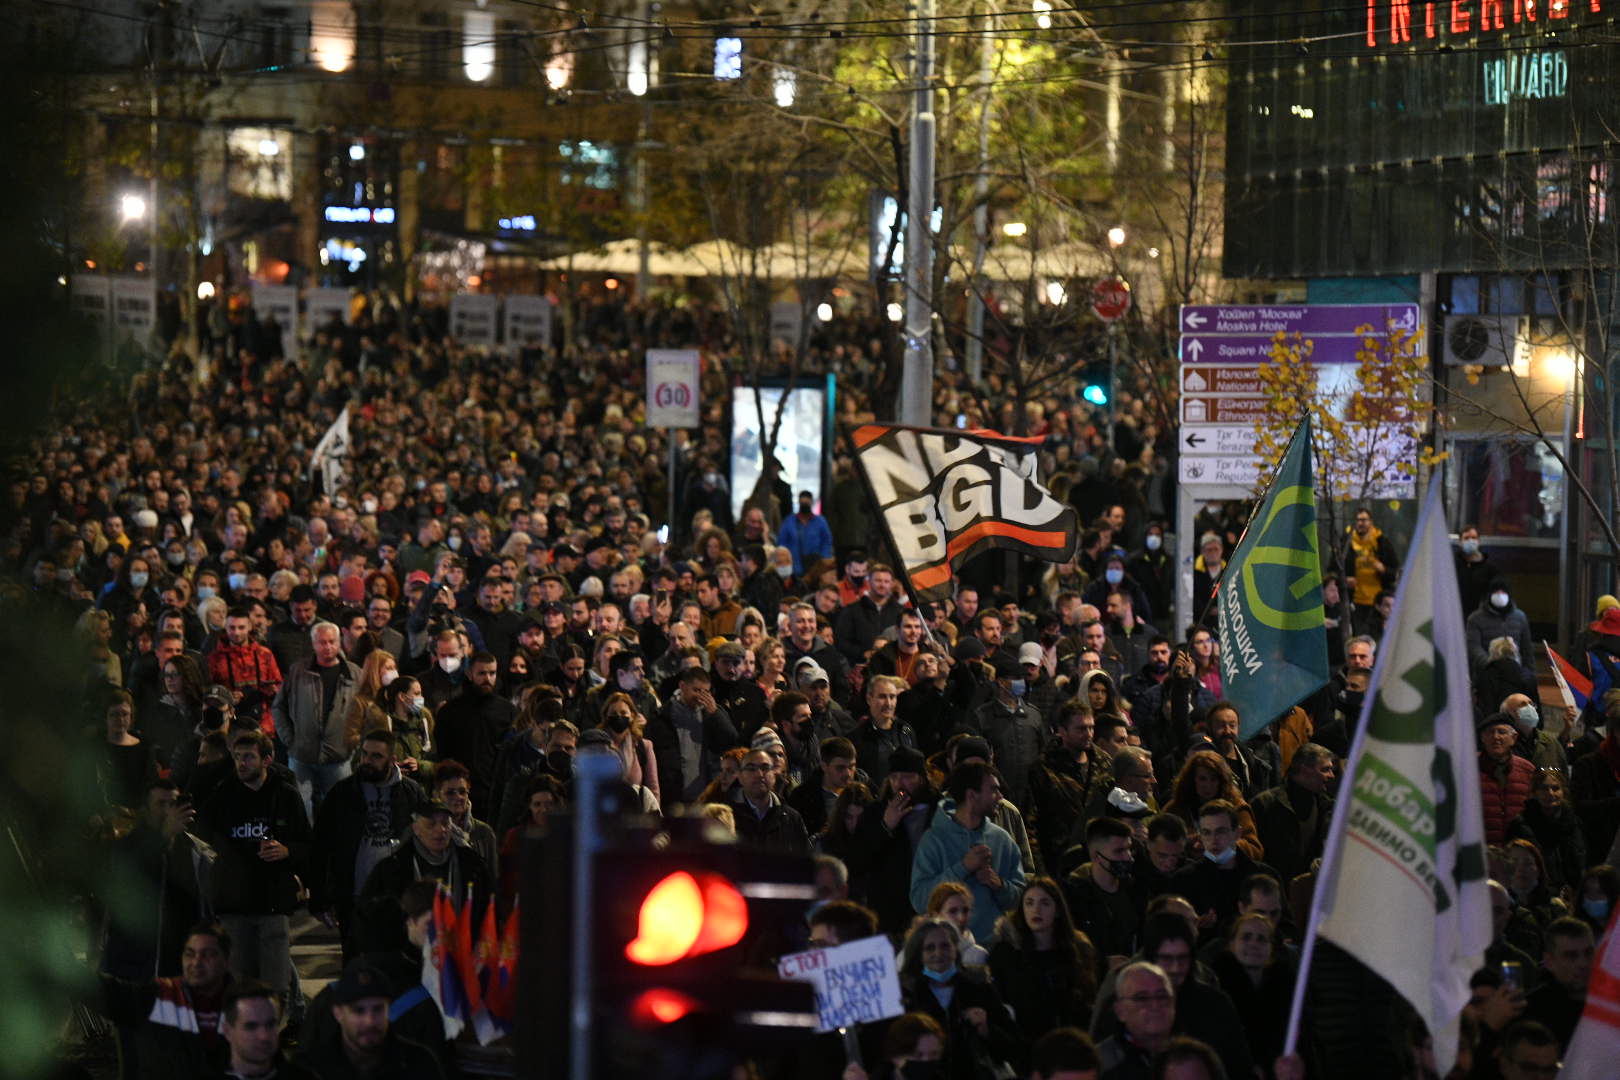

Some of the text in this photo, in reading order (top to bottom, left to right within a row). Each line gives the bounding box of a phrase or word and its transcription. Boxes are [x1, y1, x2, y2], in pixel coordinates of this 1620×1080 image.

[1216, 320, 1288, 331] Moskva Hotel
[1218, 343, 1256, 357] Square
[1216, 380, 1258, 392] National
[663, 387, 685, 406] 30
[883, 463, 1065, 571] BGD
[1218, 594, 1240, 686] СТАНАК
[231, 822, 269, 838] adid
[782, 949, 828, 978] СТОП
